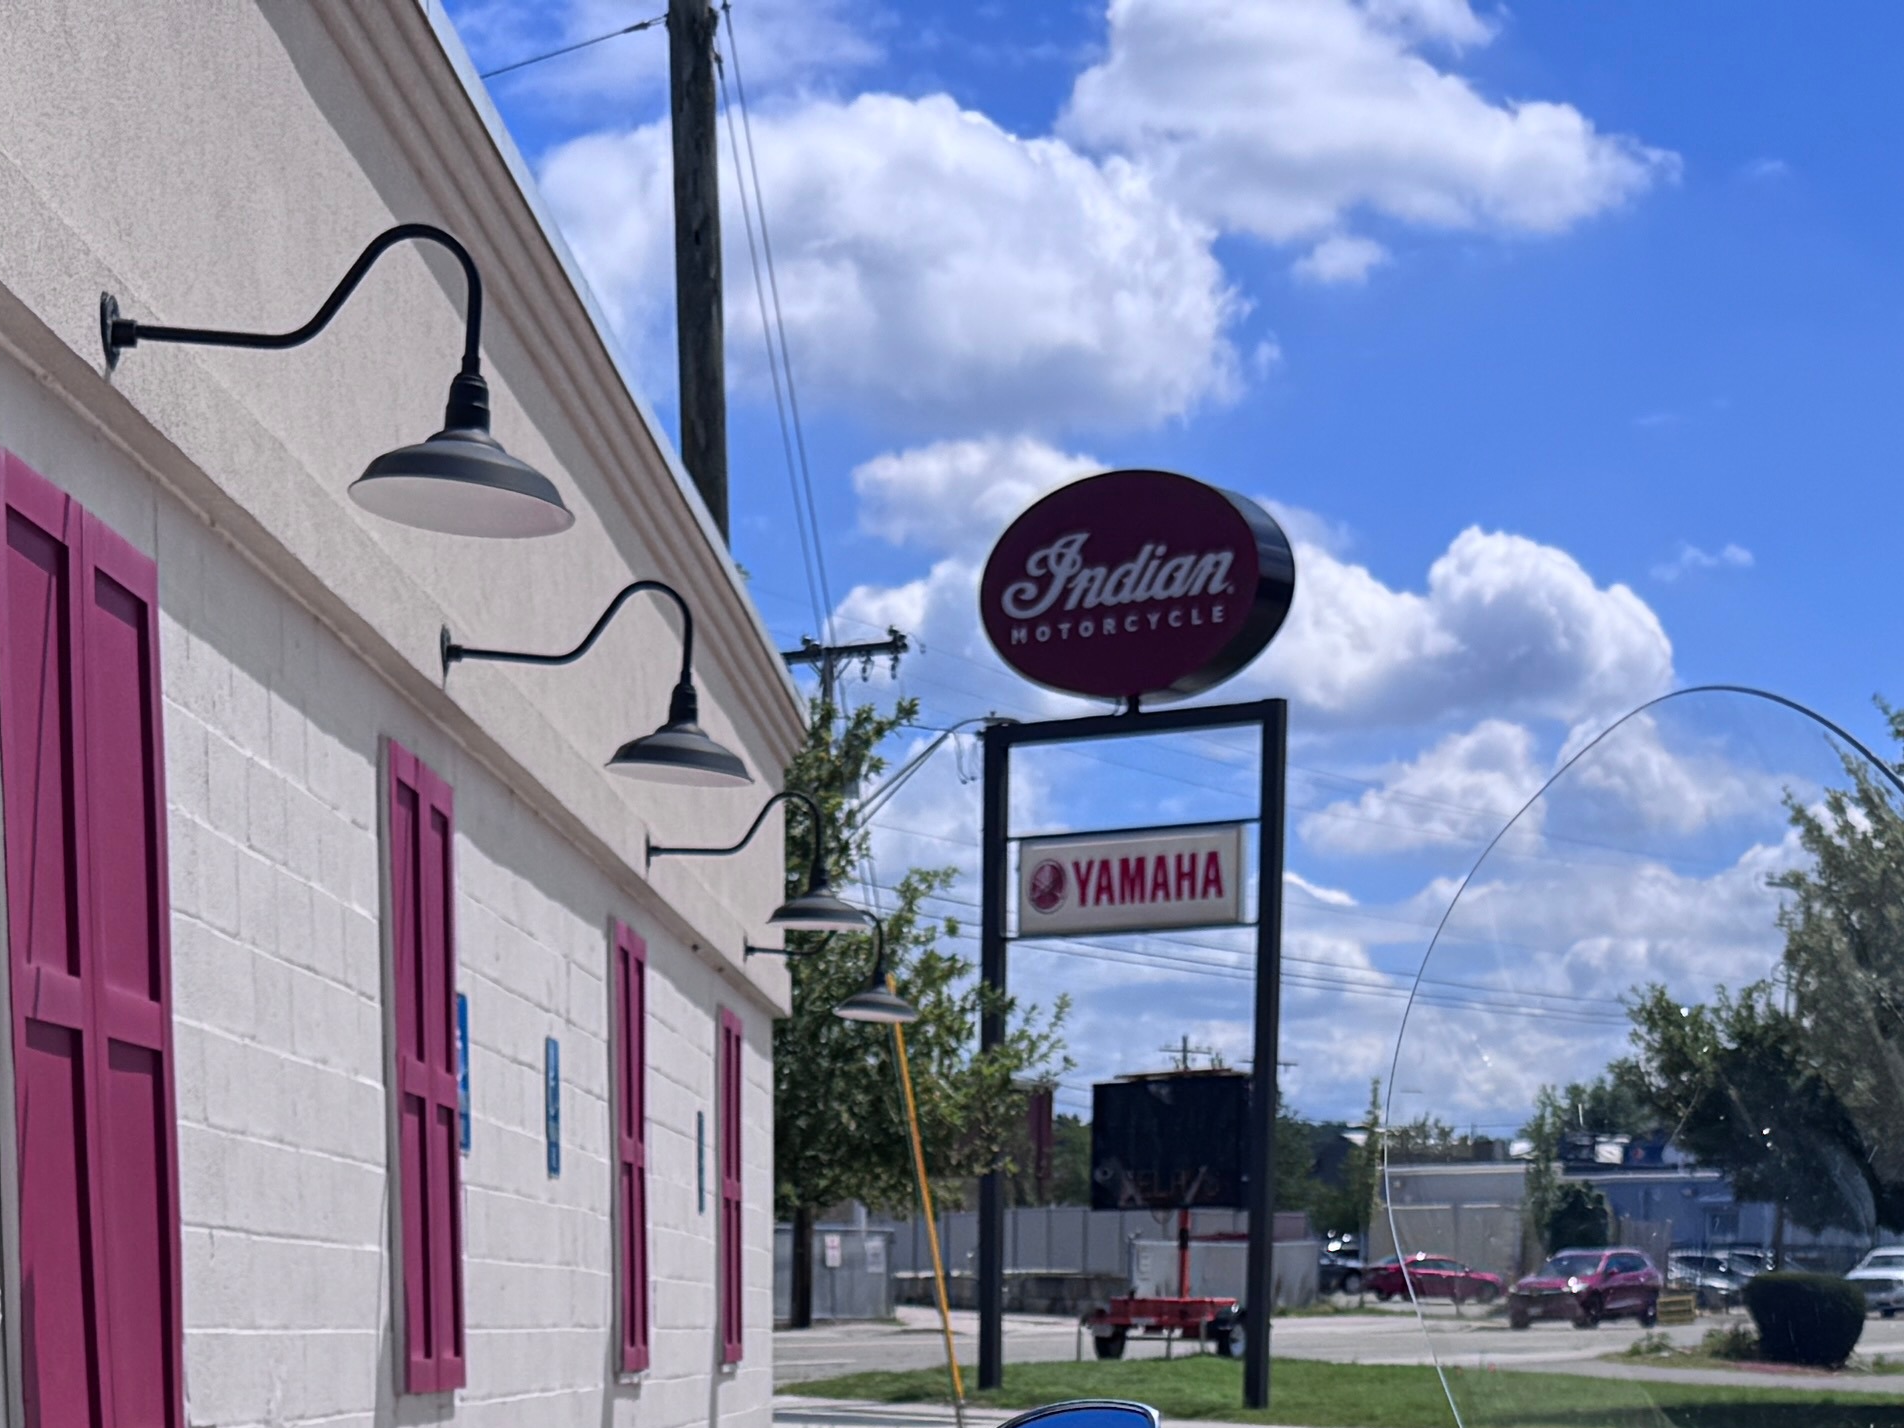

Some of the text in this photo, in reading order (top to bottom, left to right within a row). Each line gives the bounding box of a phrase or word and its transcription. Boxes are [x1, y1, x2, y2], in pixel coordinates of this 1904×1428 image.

[1002, 533, 1233, 619] Indian
[1011, 606, 1225, 645] MOTORCYCLE
[1072, 851, 1224, 908] YAMAHA
